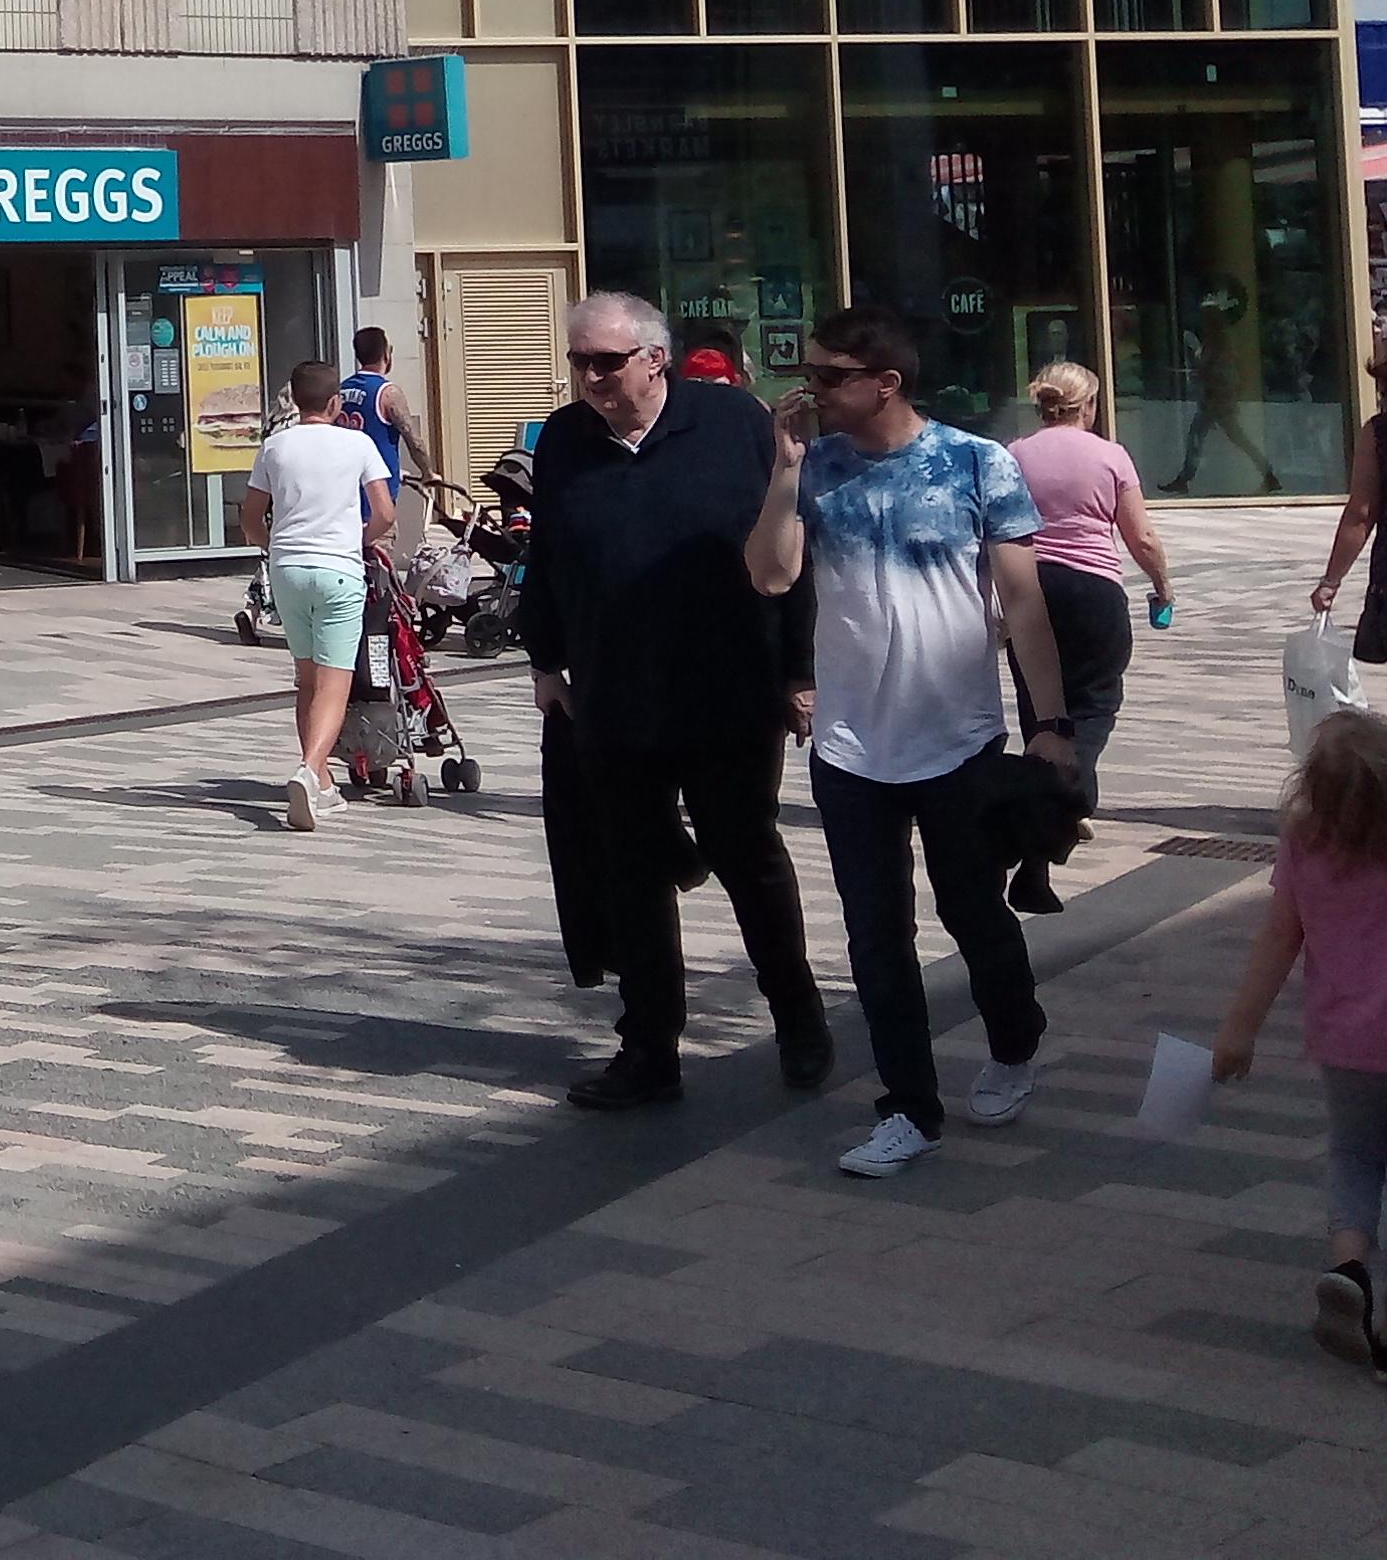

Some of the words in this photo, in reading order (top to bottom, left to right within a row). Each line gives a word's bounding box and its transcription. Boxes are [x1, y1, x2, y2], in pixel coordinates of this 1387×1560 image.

[382, 132, 443, 153] GREGGS
[951, 289, 985, 314] CAFÉ
[194, 325, 226, 342] CALM
[227, 324, 251, 341] AND
